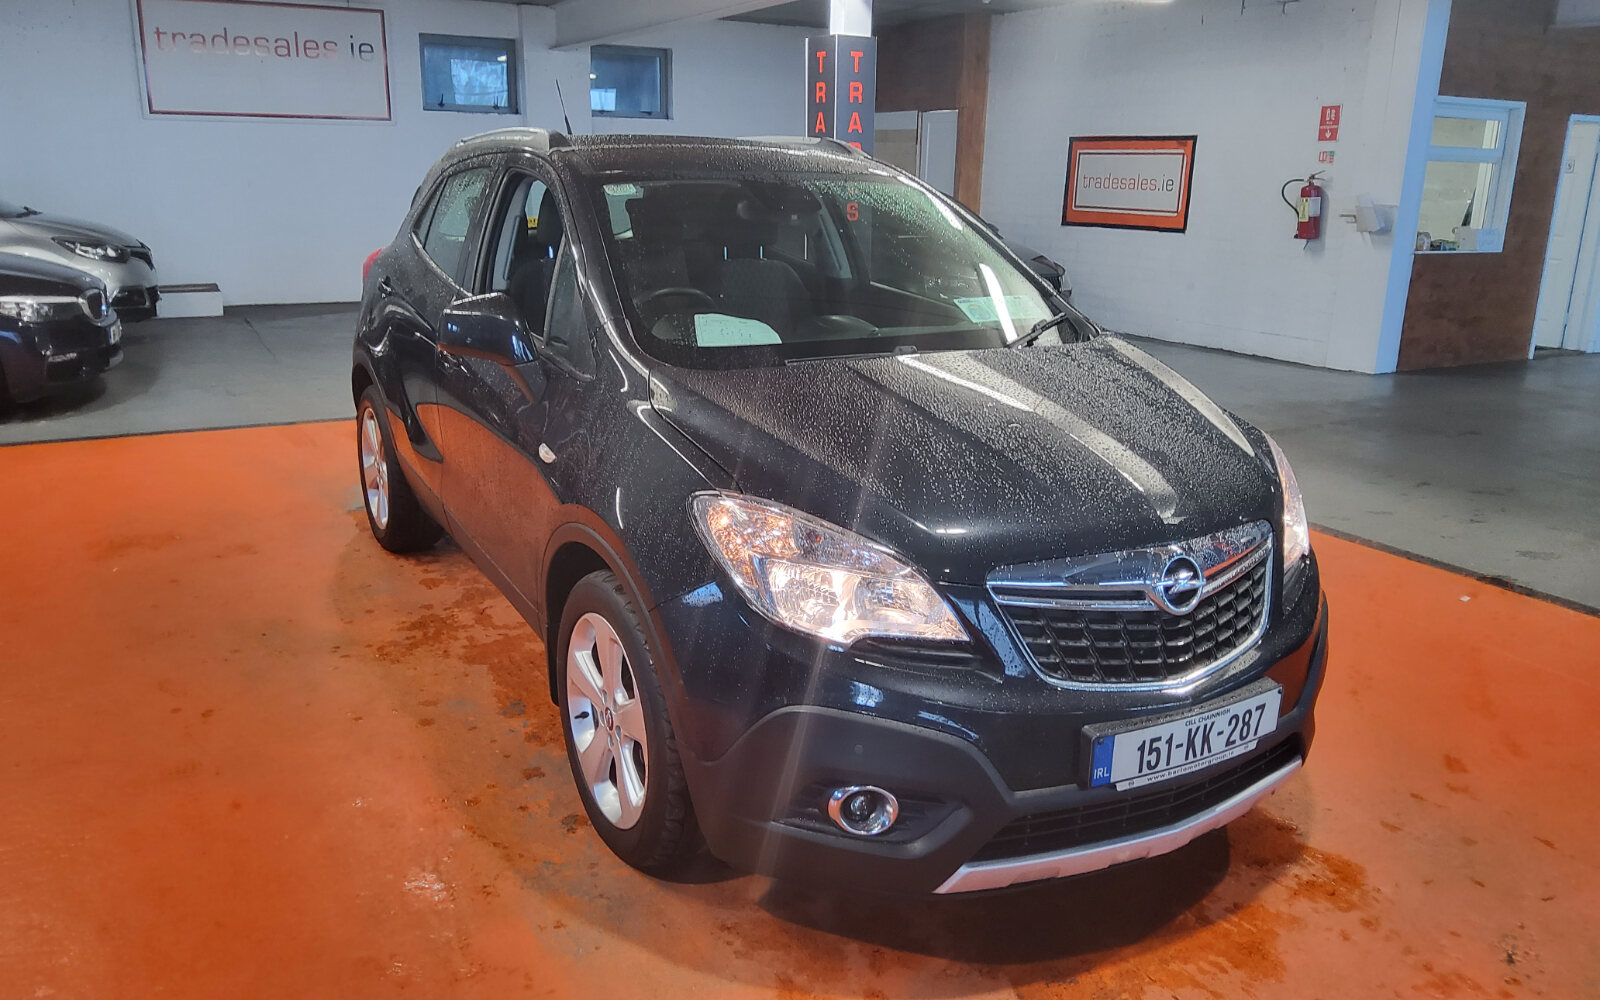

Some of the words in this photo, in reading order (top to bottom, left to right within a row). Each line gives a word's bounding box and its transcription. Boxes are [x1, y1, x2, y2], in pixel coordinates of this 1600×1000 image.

[1083, 172, 1175, 192] tradesales.ie
[1137, 703, 1267, 774] 151-KK-287
[1094, 767, 1110, 780] IRL
